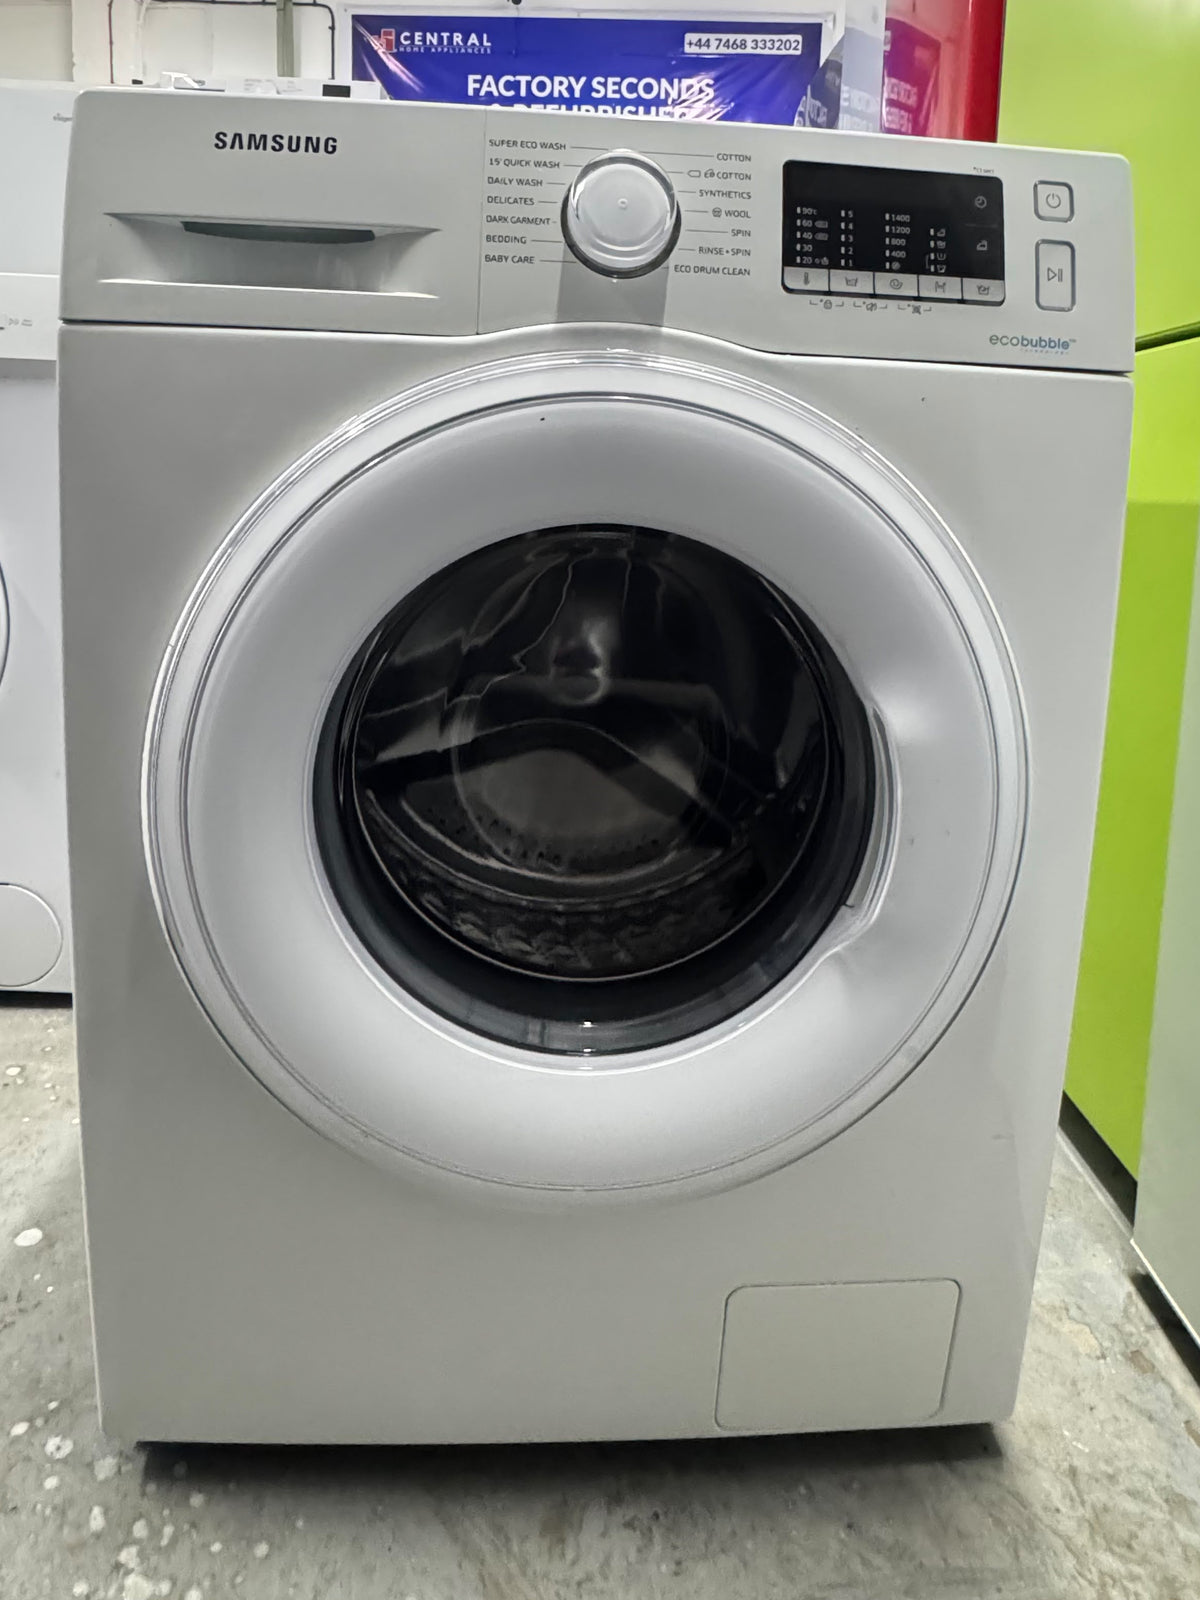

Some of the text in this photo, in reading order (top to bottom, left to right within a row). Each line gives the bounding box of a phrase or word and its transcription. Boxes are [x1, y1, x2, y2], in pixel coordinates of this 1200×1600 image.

[400, 32, 491, 46] CENTRAL
[687, 38, 800, 51] +44 7468 333202
[467, 74, 715, 100] FACTORY SECONDS
[214, 131, 338, 155] SAMSUNG
[489, 139, 566, 151] SUPER ECO WASH
[716, 153, 751, 162] COTTON
[503, 158, 531, 167] QUICK
[534, 160, 560, 169] WASH
[717, 171, 751, 181] COTTON
[487, 176, 543, 187] DAILY WASH
[699, 189, 752, 200] SYNTHETICS
[487, 195, 535, 206] DELICATES
[725, 210, 751, 219] WOOL
[891, 213, 911, 222] 1400
[486, 215, 551, 226] DARK GARMENT
[802, 219, 813, 227] 60
[731, 228, 751, 237] SPIN
[891, 226, 911, 234] 1200
[486, 235, 527, 245] BEDDING
[802, 232, 813, 240] 40
[802, 244, 813, 252] 30
[485, 254, 535, 264] BABY CARE
[802, 256, 813, 264] 20
[891, 251, 906, 259] 400
[674, 264, 751, 276] ECO DRUM CLEAN
[989, 334, 1070, 351] ecobubble
